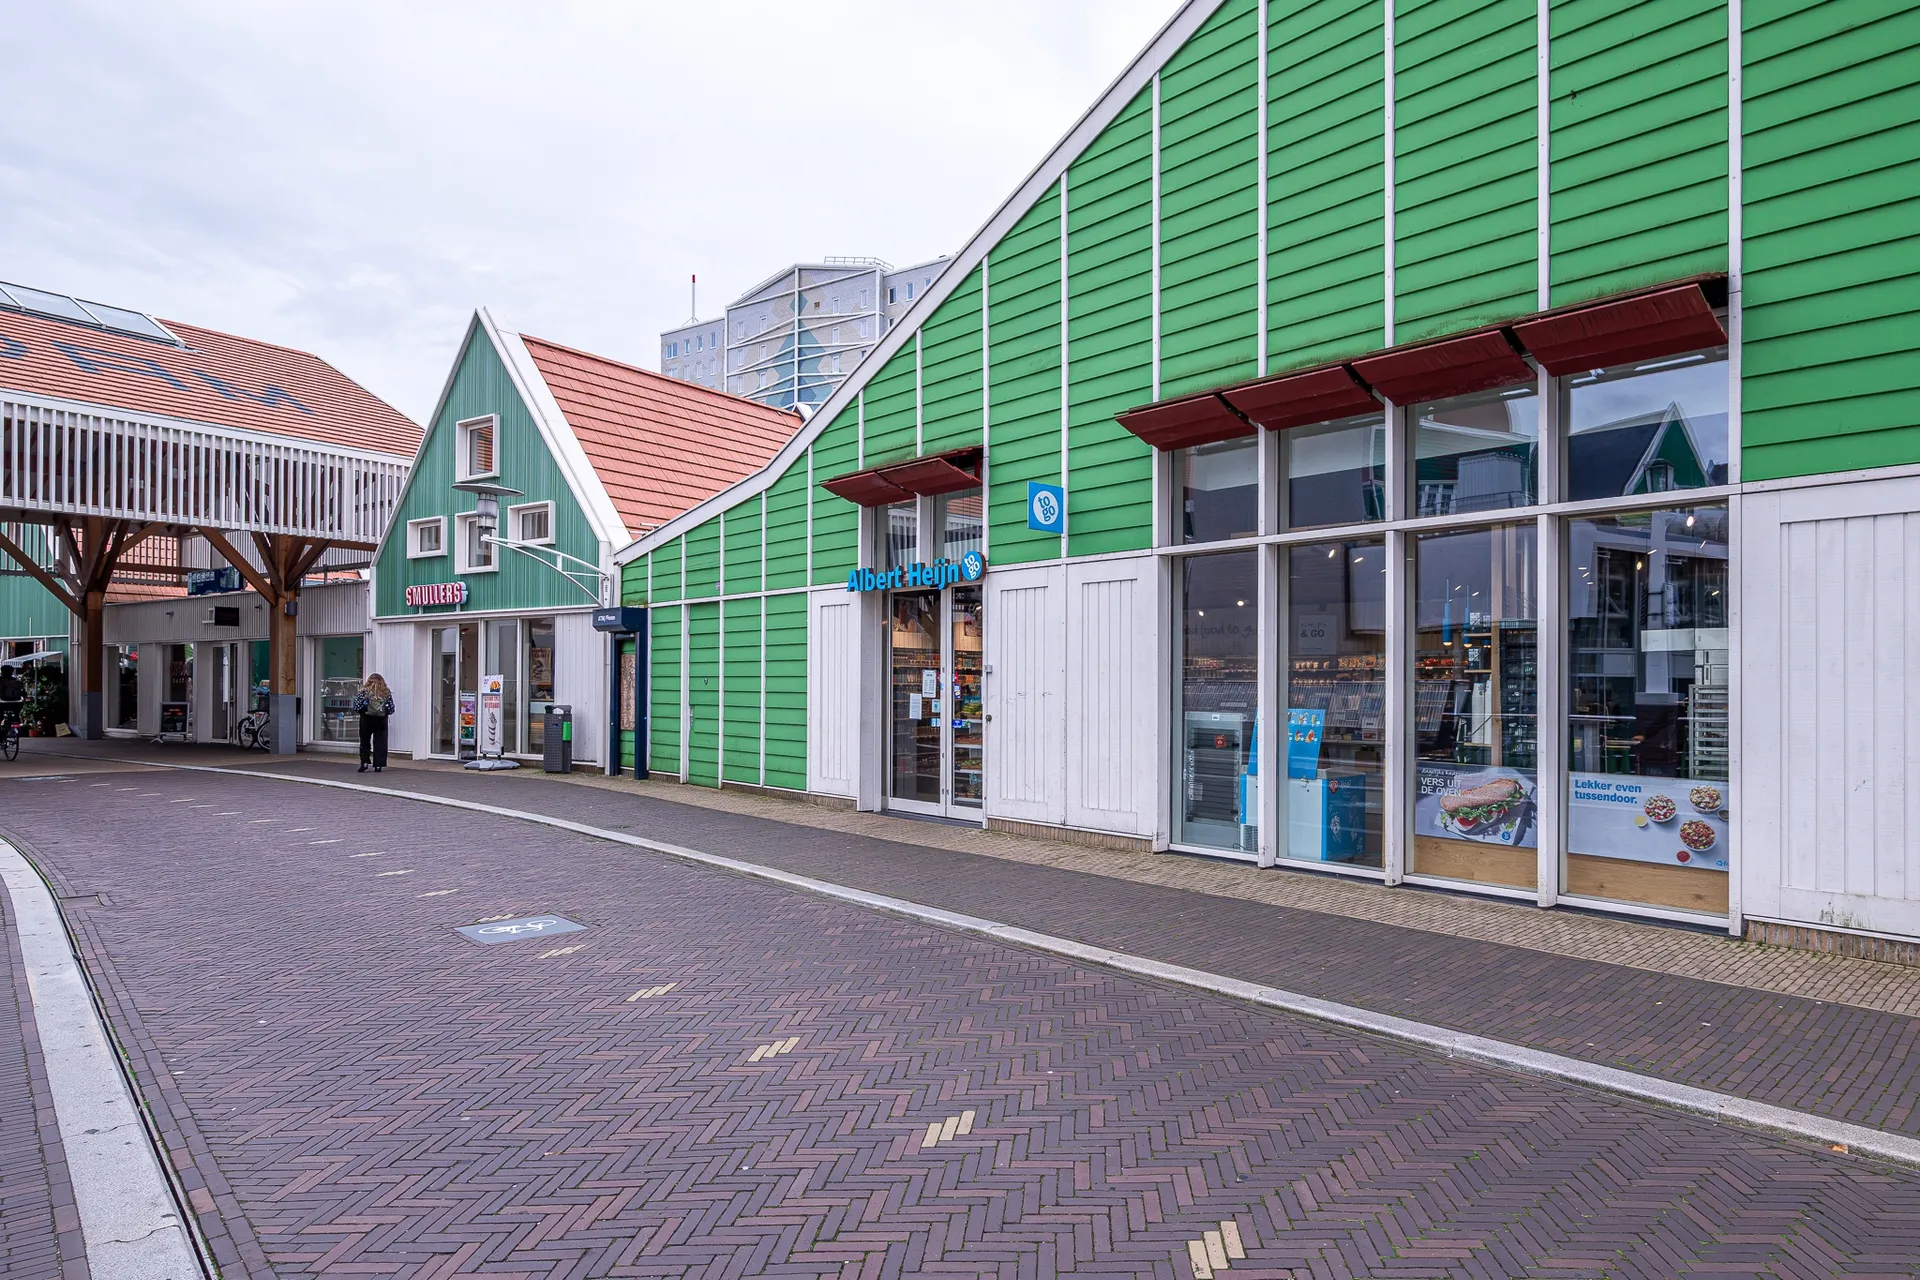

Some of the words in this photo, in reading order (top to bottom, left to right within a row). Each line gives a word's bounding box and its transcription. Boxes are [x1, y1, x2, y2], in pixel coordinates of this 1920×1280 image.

[1037, 496, 1051, 509] to
[1042, 505, 1056, 522] go
[964, 554, 975, 567] to
[847, 566, 902, 592] Albert
[908, 558, 959, 590] Heijn
[968, 563, 980, 579] go
[405, 582, 466, 606] SMULLERS
[1310, 629, 1325, 638] GO
[1421, 777, 1444, 787] VERS
[1447, 779, 1462, 788] UIT
[1574, 779, 1612, 791] Lekker
[1615, 784, 1642, 793] even
[1421, 786, 1434, 795] DE
[1436, 787, 1461, 797] OVEN
[1574, 790, 1638, 804] tussendoor.
